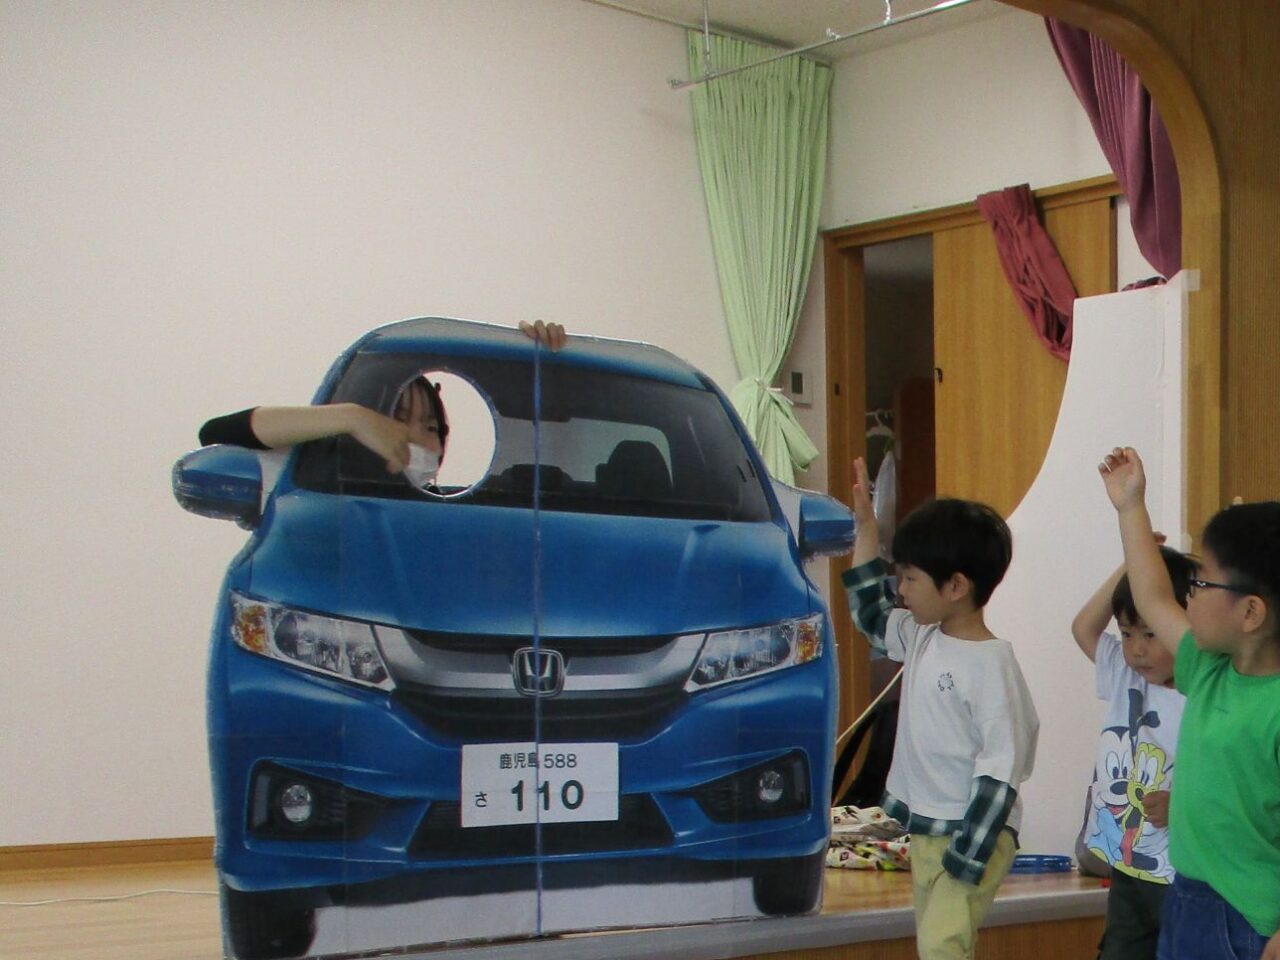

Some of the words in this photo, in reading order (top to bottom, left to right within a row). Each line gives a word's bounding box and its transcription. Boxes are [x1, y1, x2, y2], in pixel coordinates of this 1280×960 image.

[544, 753, 577, 769] 588
[474, 791, 488, 808] さ
[511, 779, 584, 812] 110
